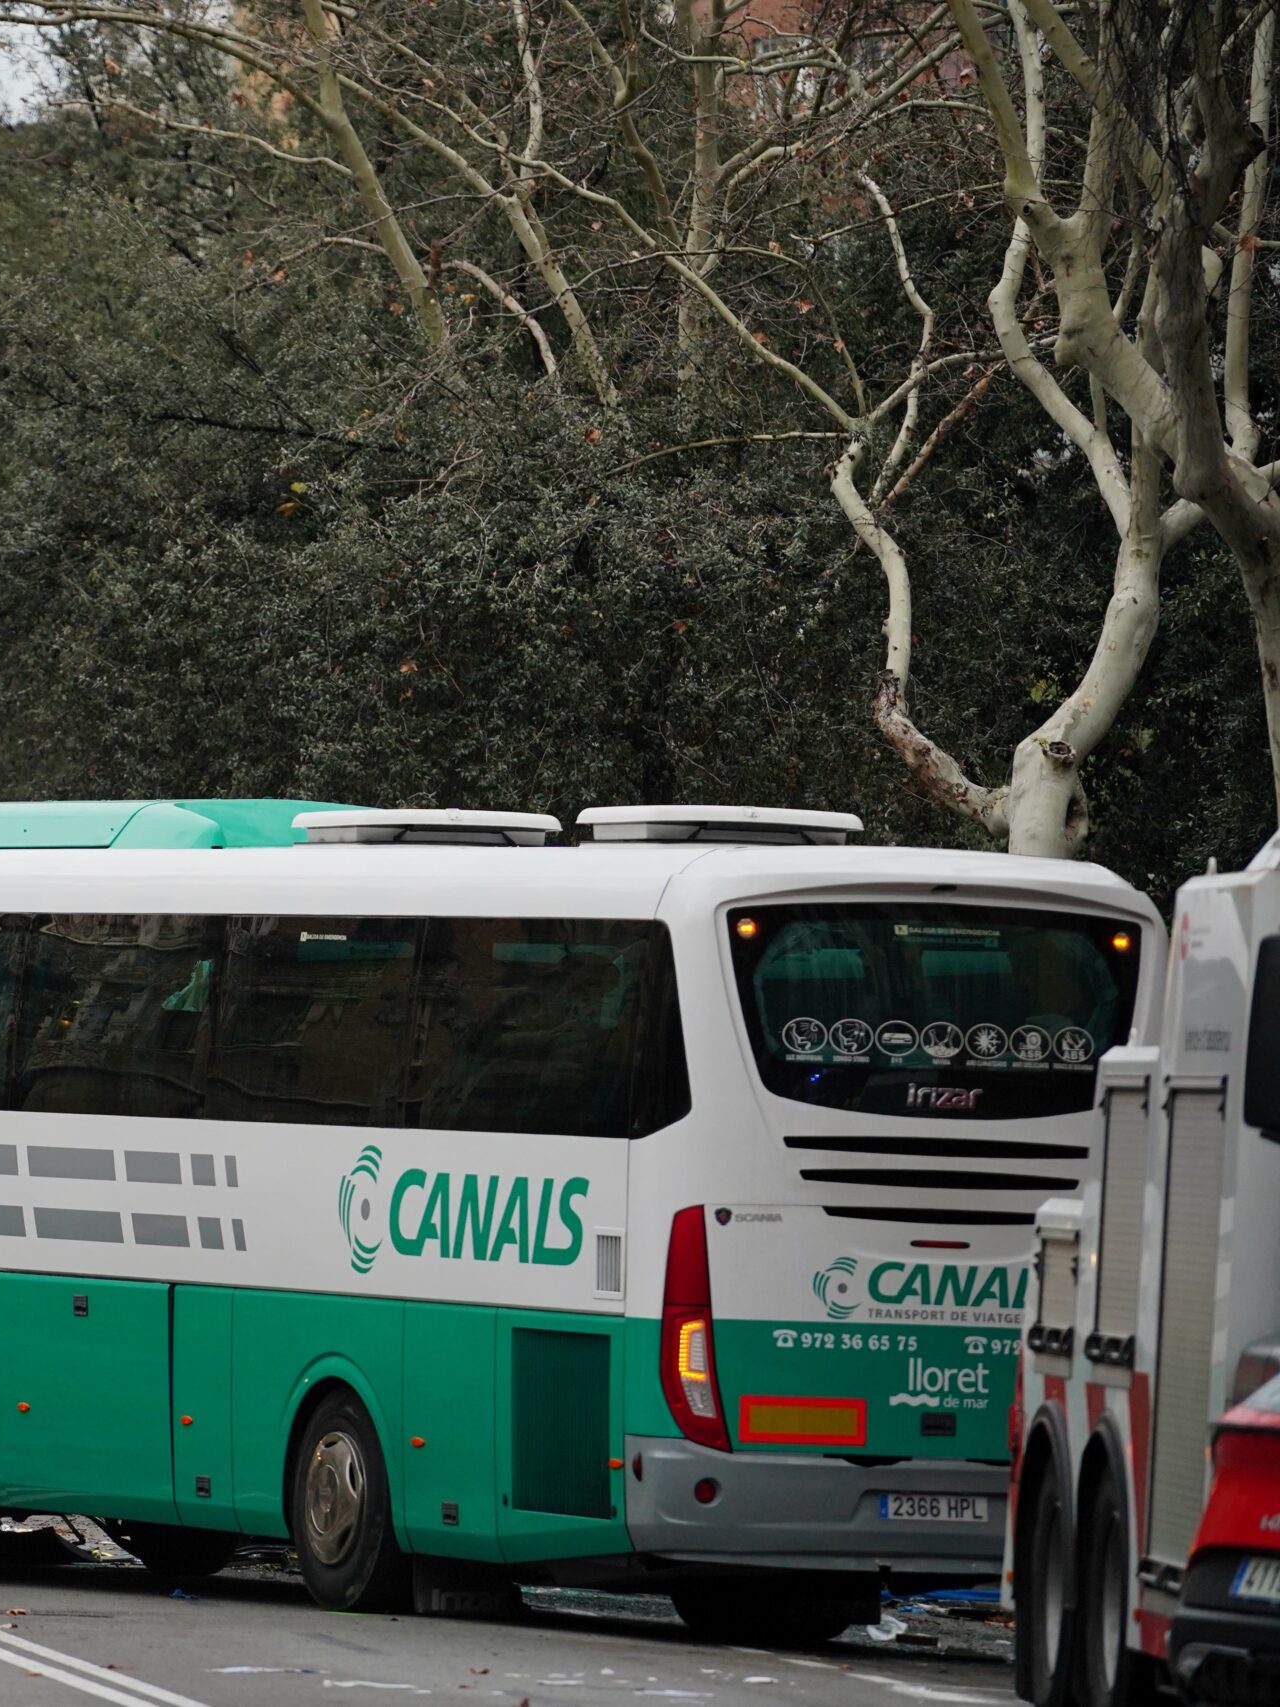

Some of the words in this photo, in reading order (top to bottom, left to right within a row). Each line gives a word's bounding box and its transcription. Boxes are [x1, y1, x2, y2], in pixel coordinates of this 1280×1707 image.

[1063, 1052, 1086, 1060] ABS
[389, 1168, 590, 1266] CANALS
[735, 1213, 783, 1222] SCANIA
[869, 1308, 945, 1321] TRANSPORT
[950, 1311, 967, 1322] DE
[801, 1332, 835, 1349] 972
[841, 1334, 863, 1350] 36
[868, 1335, 890, 1350] 65
[897, 1336, 918, 1351] 75
[908, 1357, 990, 1393] lloret
[943, 1395, 960, 1408] de
[963, 1398, 989, 1409] mar
[893, 1496, 941, 1518] 2366
[947, 1498, 984, 1519] HPL
